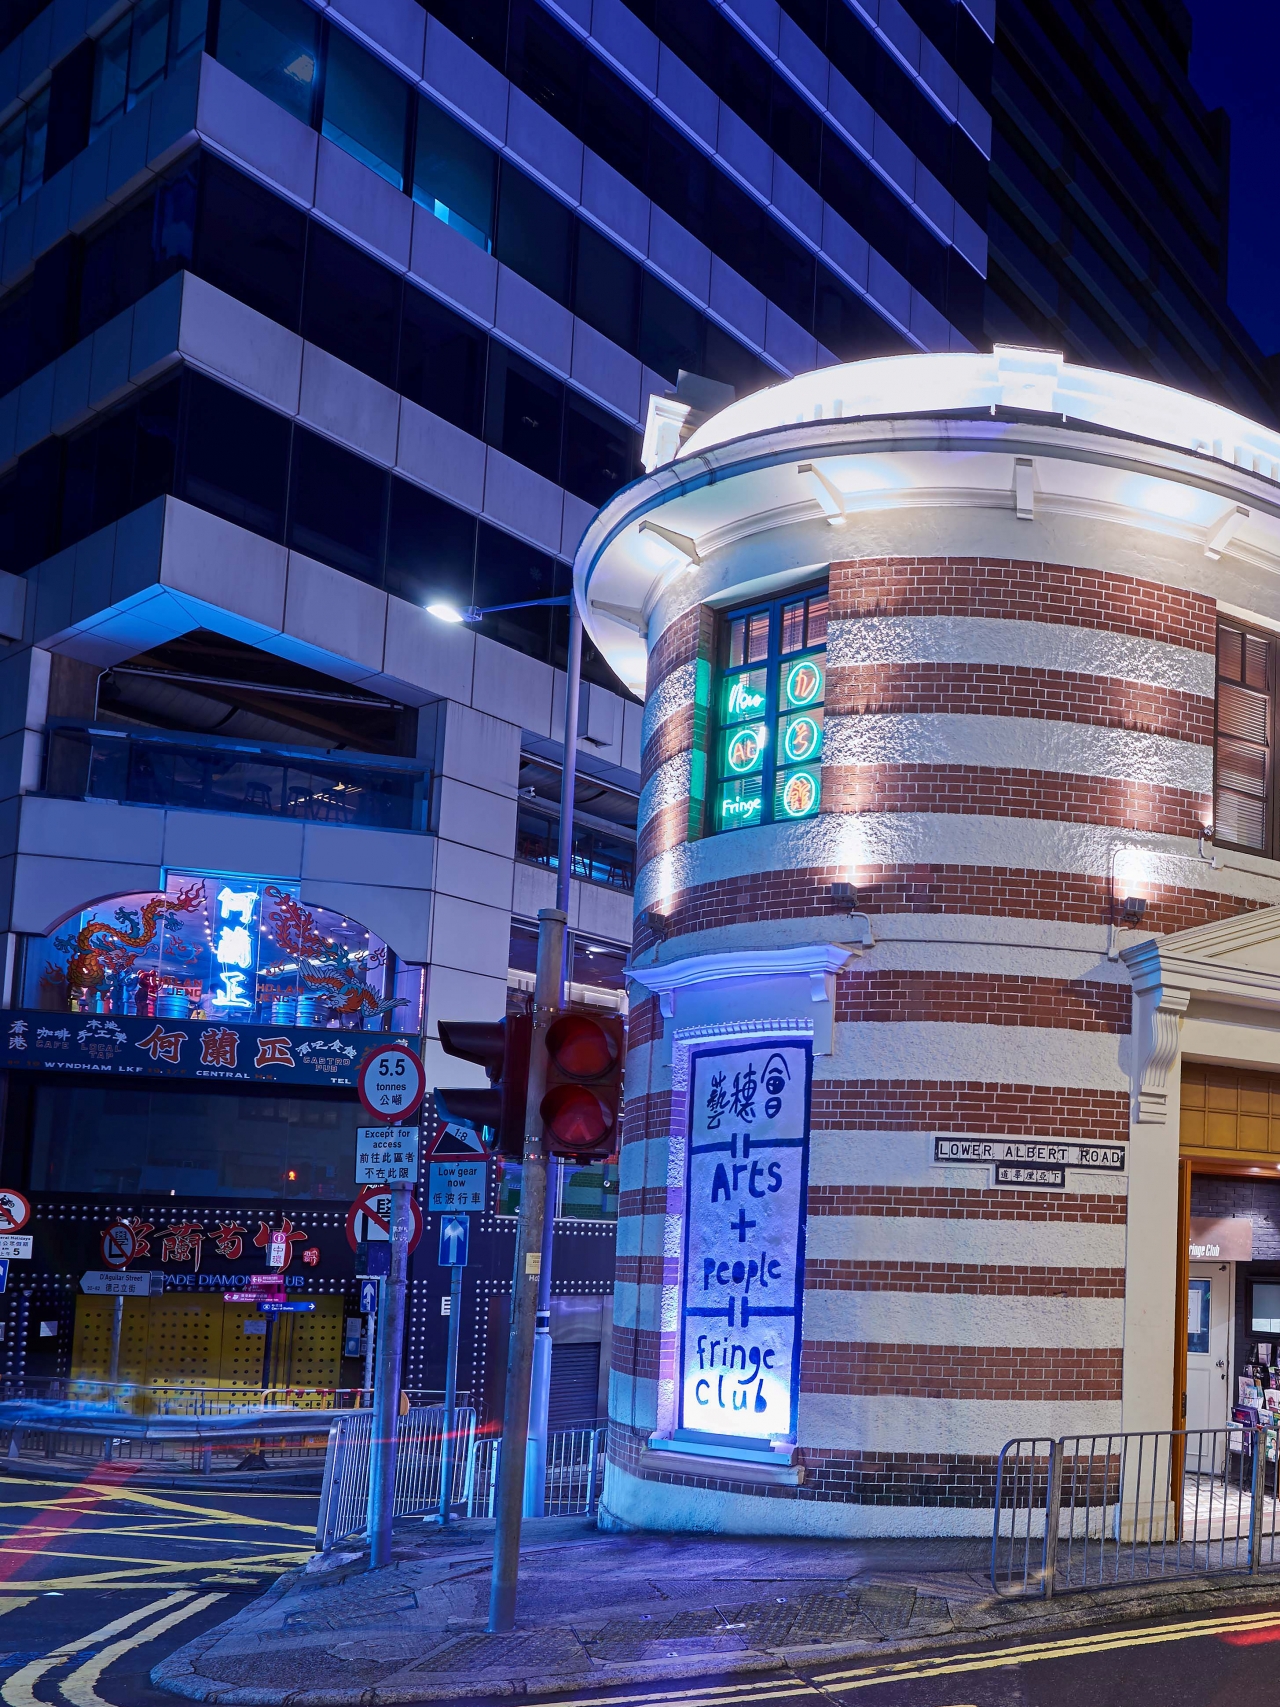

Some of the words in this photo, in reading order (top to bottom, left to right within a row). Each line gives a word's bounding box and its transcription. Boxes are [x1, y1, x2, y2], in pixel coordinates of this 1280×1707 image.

[722, 796, 762, 818] Fringe
[8, 1020, 29, 1050] 香港
[36, 1026, 72, 1042] 咖啡
[35, 1040, 70, 1050] CAFE
[80, 1043, 123, 1053] LOCAL
[134, 1024, 296, 1069] 何蘭正
[89, 1051, 114, 1060] TAP
[303, 1056, 351, 1066] GASTRO
[44, 1061, 112, 1071] WYNDHAM
[118, 1065, 144, 1073] LKF
[195, 1070, 251, 1079] CENTRAL
[315, 1064, 338, 1073] PUB
[378, 1058, 406, 1077] 5.5
[376, 1083, 407, 1091] tonnes
[364, 1130, 395, 1139] Except
[398, 1129, 411, 1138] for
[453, 1127, 469, 1142] 1:8
[372, 1140, 402, 1149] access
[359, 1152, 415, 1164] 前往此區者
[939, 1143, 992, 1157] LOWER
[1005, 1146, 1068, 1161] ALBERT
[1080, 1149, 1121, 1164] ROAD
[364, 1167, 410, 1179] 不在此限
[438, 1166, 456, 1176] Low
[457, 1167, 478, 1179] gear
[447, 1180, 466, 1188] now
[711, 1161, 783, 1203] Arts
[432, 1192, 482, 1206] 低波行車
[13, 1247, 20, 1256] 5
[1189, 1243, 1207, 1258] ringe
[1205, 1244, 1220, 1257] Club
[99, 1274, 125, 1283] D'Aguilar
[125, 1274, 143, 1282] Street
[162, 1275, 196, 1287] PADE
[198, 1275, 252, 1287] DIAMON
[696, 1335, 776, 1385] fringe
